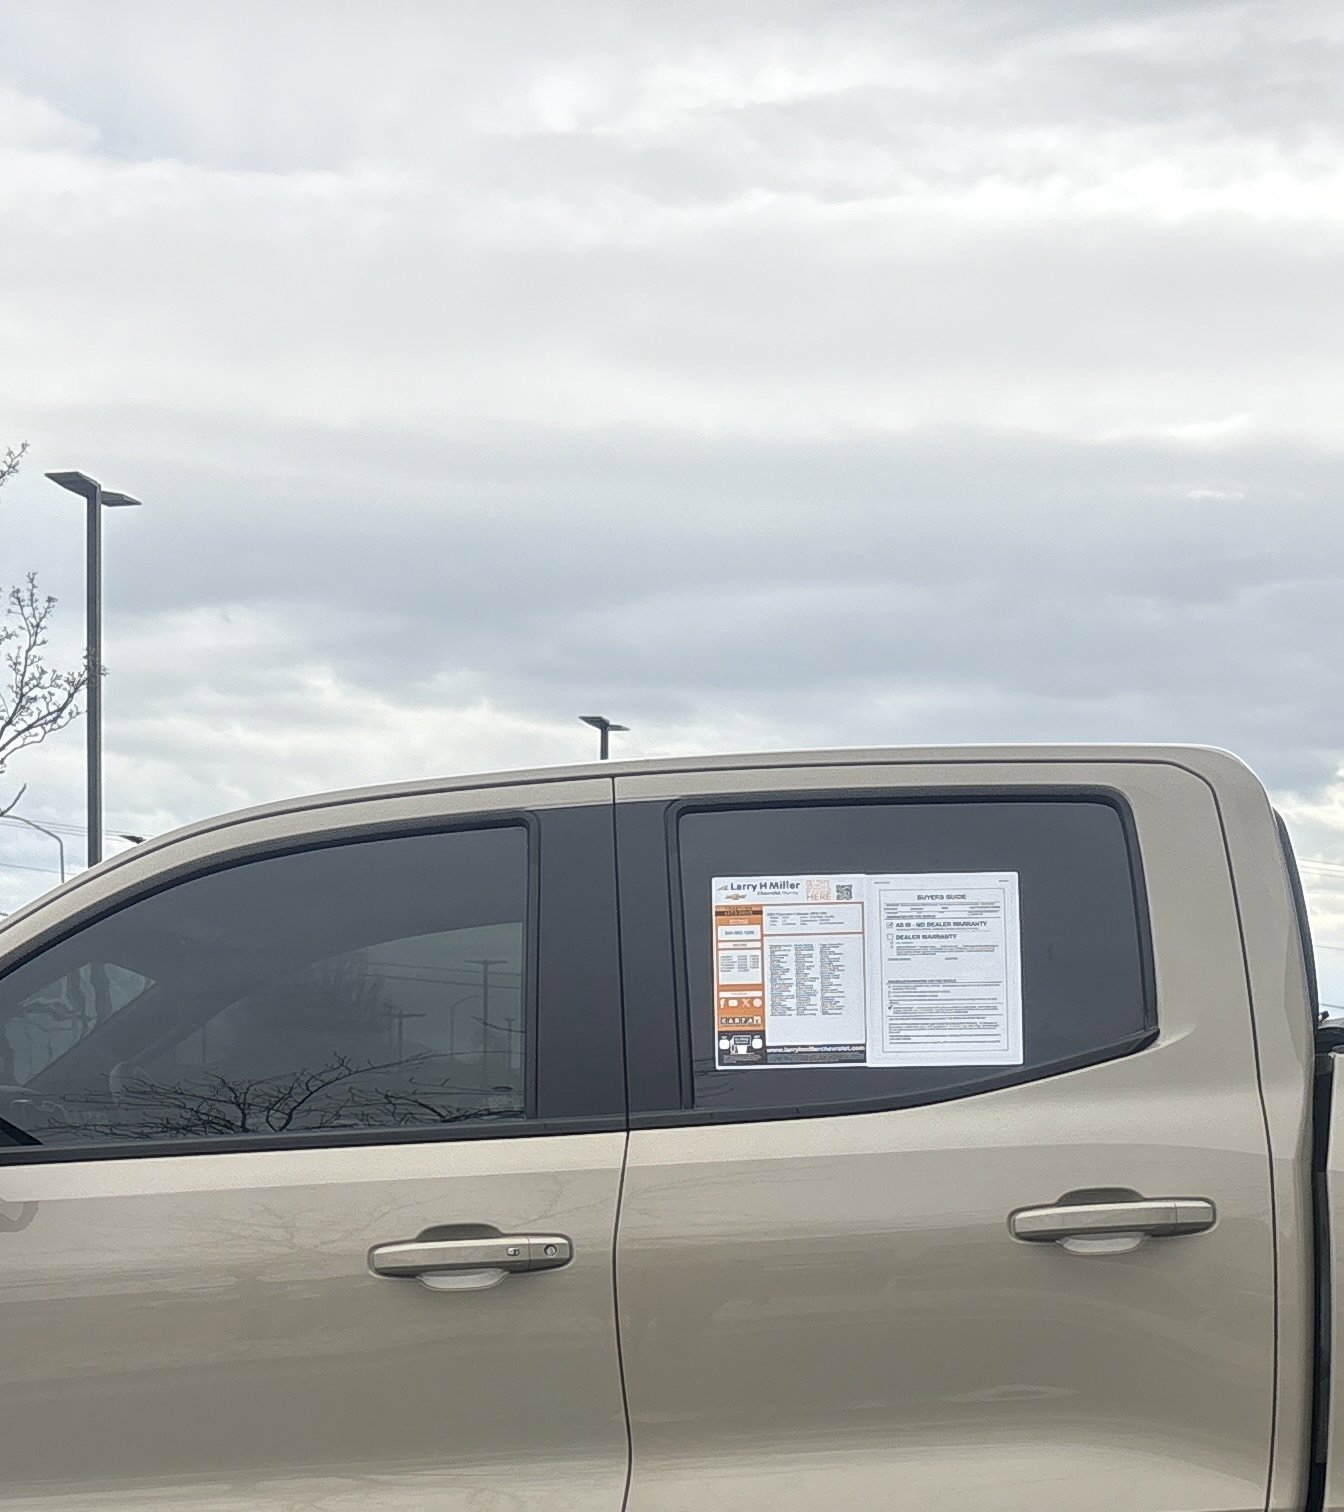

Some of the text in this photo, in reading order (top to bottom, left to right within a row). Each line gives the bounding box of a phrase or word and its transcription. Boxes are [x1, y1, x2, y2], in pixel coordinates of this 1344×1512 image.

[730, 881, 757, 892] Larry
[759, 881, 767, 889] H
[769, 880, 801, 890] Miller
